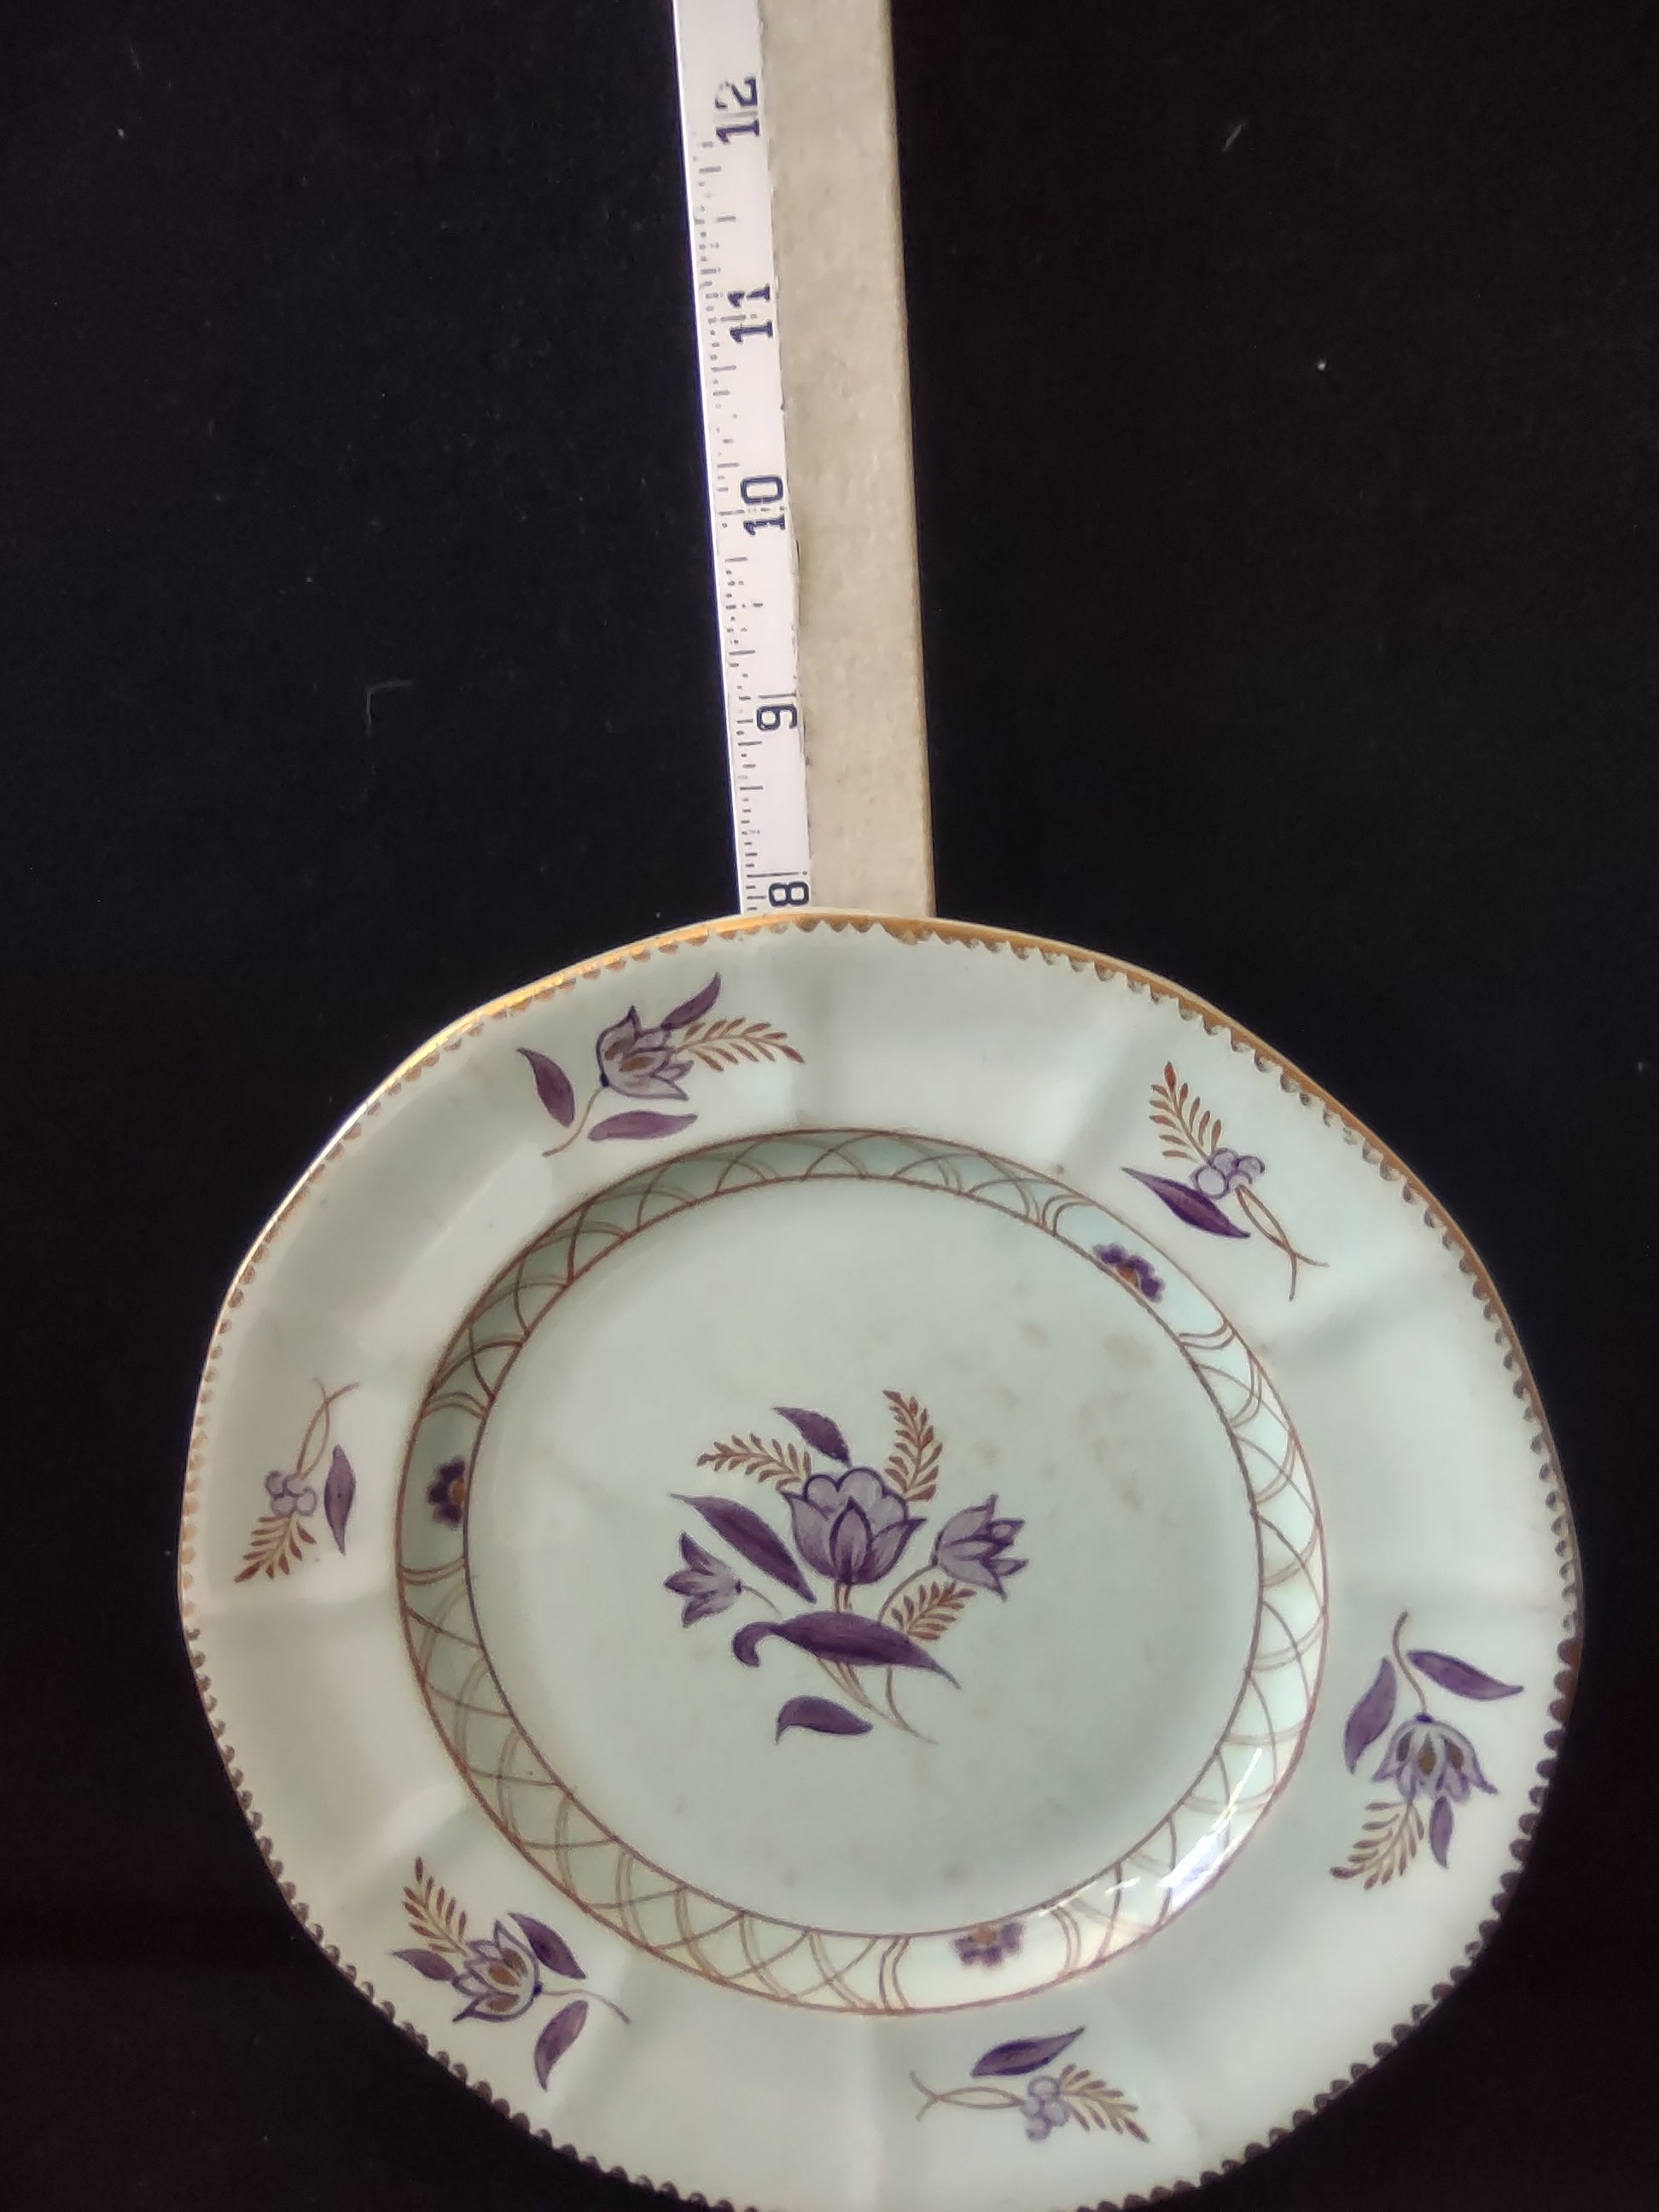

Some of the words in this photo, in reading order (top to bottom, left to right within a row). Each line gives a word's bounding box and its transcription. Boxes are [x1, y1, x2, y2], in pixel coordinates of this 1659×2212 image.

[714, 75, 760, 143] 12
[728, 282, 773, 343] 11
[741, 475, 785, 535] 10
[757, 704, 798, 731] 9
[768, 881, 810, 907] 8
